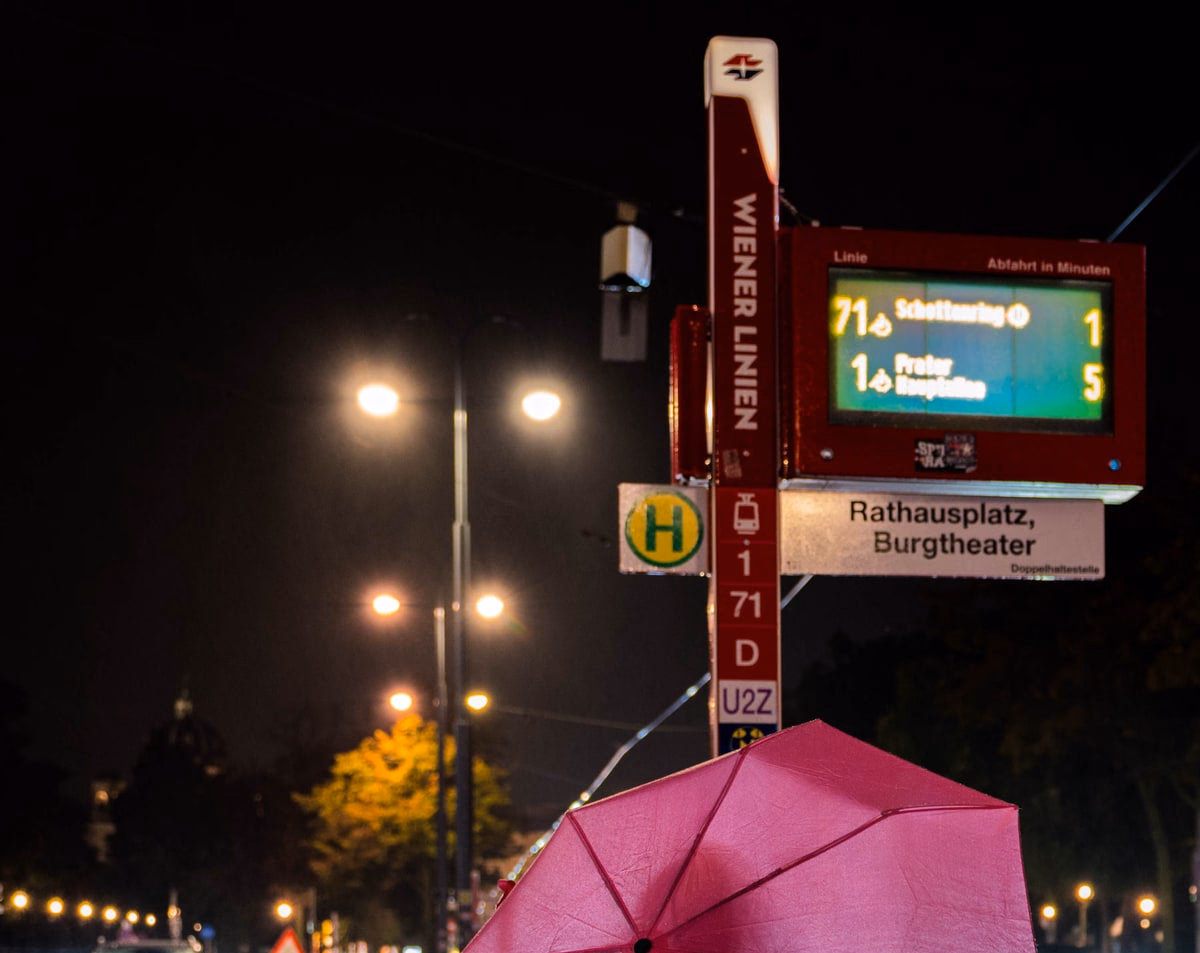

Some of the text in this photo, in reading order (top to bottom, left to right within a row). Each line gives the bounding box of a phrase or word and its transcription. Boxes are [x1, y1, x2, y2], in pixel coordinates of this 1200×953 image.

[834, 251, 868, 264] Linie
[987, 257, 1111, 276] Abfahrt in Minuten
[733, 193, 759, 430] WIENER LINIEN
[832, 296, 868, 336] 71
[1083, 308, 1102, 347] 1
[850, 353, 868, 392] 1
[1082, 363, 1104, 402] 5
[645, 504, 684, 552] H
[850, 500, 1036, 529] Rathausplatz,
[873, 531, 1037, 559] Burgtheater
[737, 550, 750, 577] 1
[1010, 563, 1100, 575] Doppelhaltestelle
[730, 591, 761, 618] 71
[735, 639, 760, 667] D
[722, 688, 773, 715] U2Z
